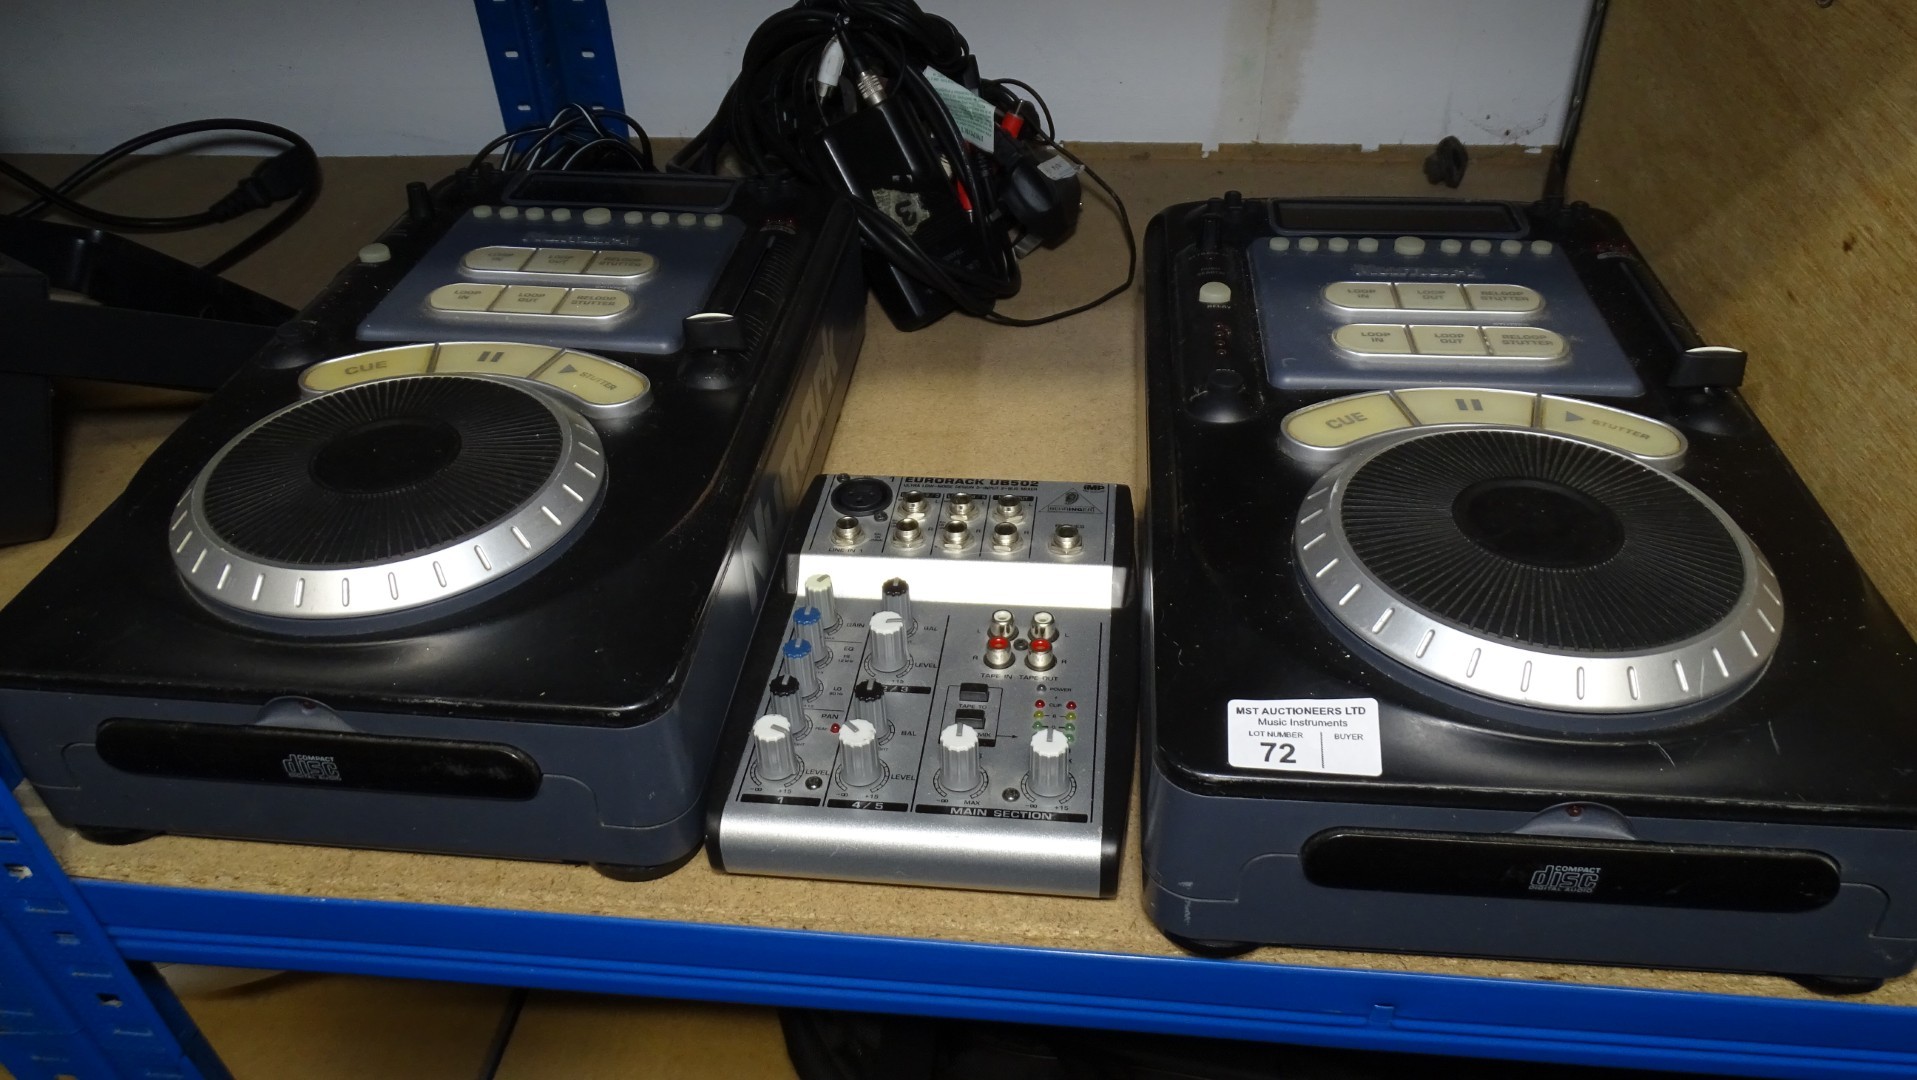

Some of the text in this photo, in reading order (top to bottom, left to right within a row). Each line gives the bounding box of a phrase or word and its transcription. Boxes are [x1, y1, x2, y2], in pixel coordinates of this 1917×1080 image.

[344, 360, 388, 376] CUE
[580, 371, 618, 391] STUTTER
[1325, 409, 1368, 430] CUE
[1592, 419, 1651, 440] STUTTER
[905, 476, 1039, 487] EURORACK UB502
[1236, 707, 1366, 715] MST AUCTIONEERS LTD
[1258, 718, 1348, 727] Music Instruments
[297, 754, 334, 762] COMPACT
[1260, 742, 1297, 764] 72
[283, 754, 340, 776] disc
[777, 796, 784, 804] 1
[951, 807, 1052, 820] MAIN SECTION
[1530, 865, 1599, 889] disc
